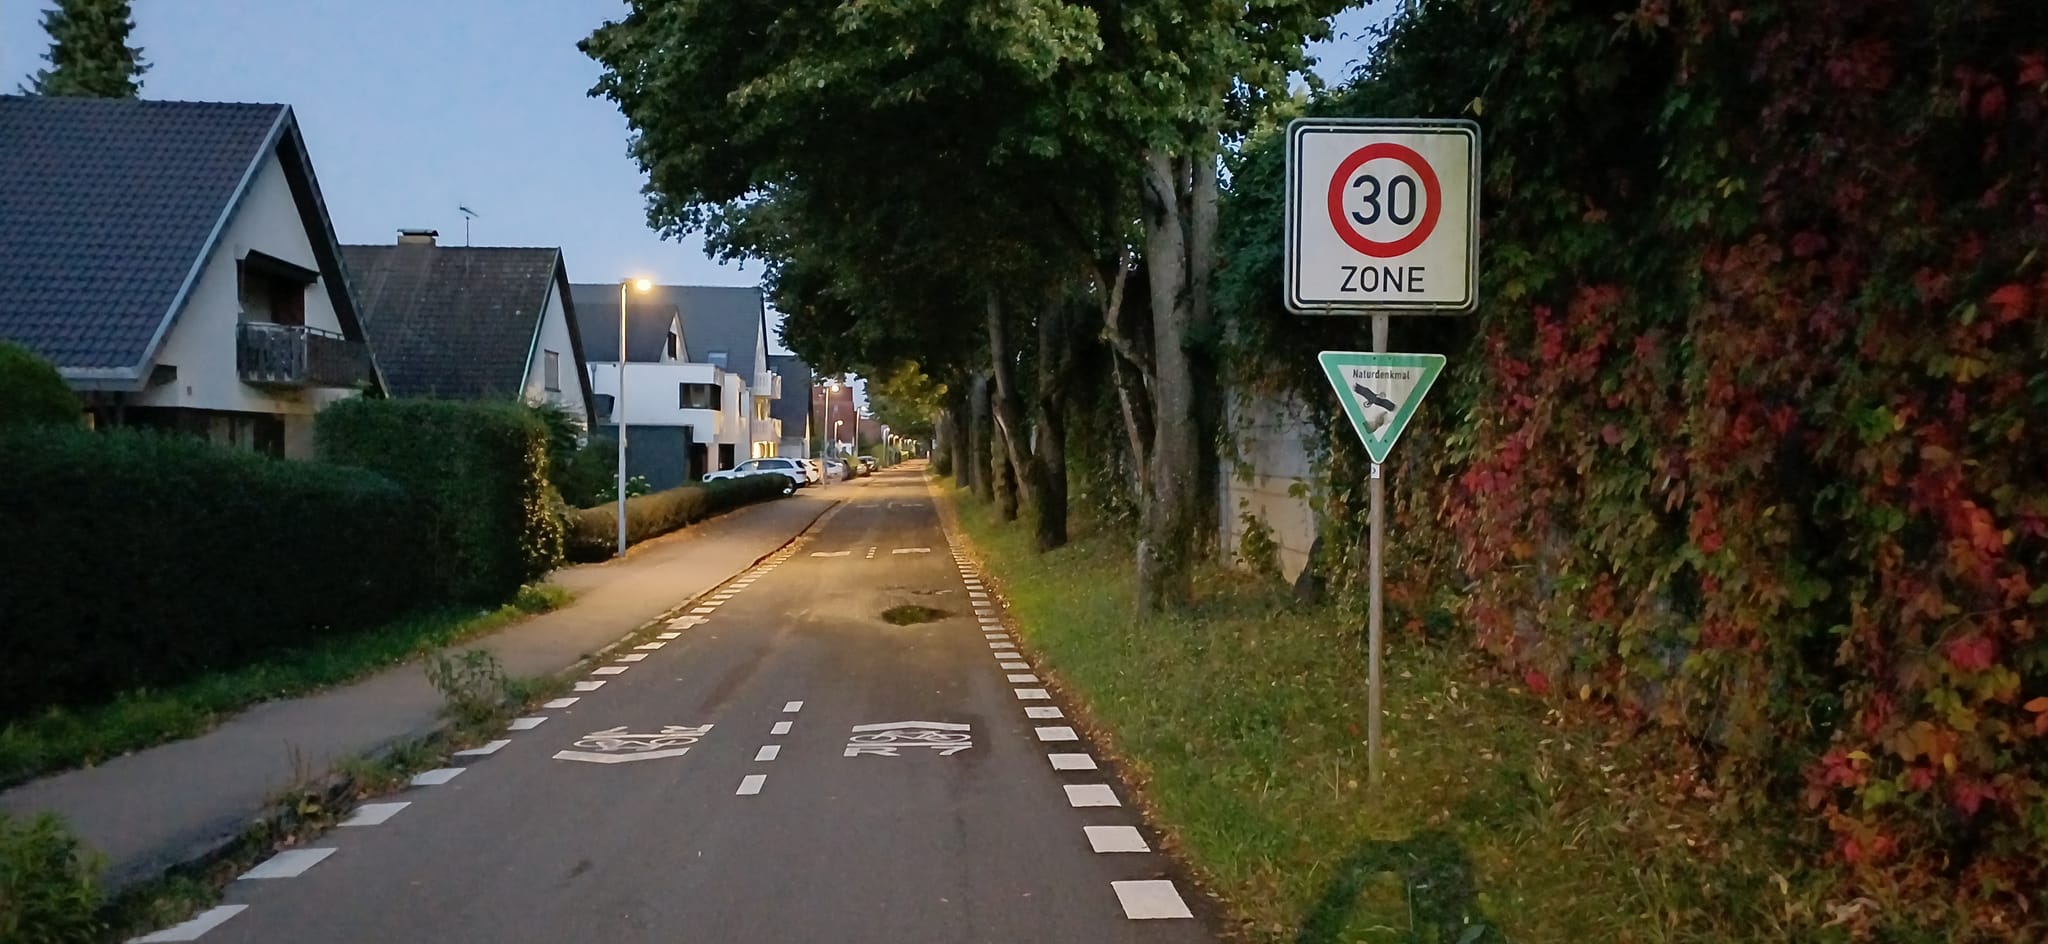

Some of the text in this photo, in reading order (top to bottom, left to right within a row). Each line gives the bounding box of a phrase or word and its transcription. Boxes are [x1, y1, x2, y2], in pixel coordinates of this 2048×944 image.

[1351, 174, 1417, 226] 30
[1340, 265, 1425, 293] ZONE
[1352, 369, 1410, 380] Naturdenkmal
